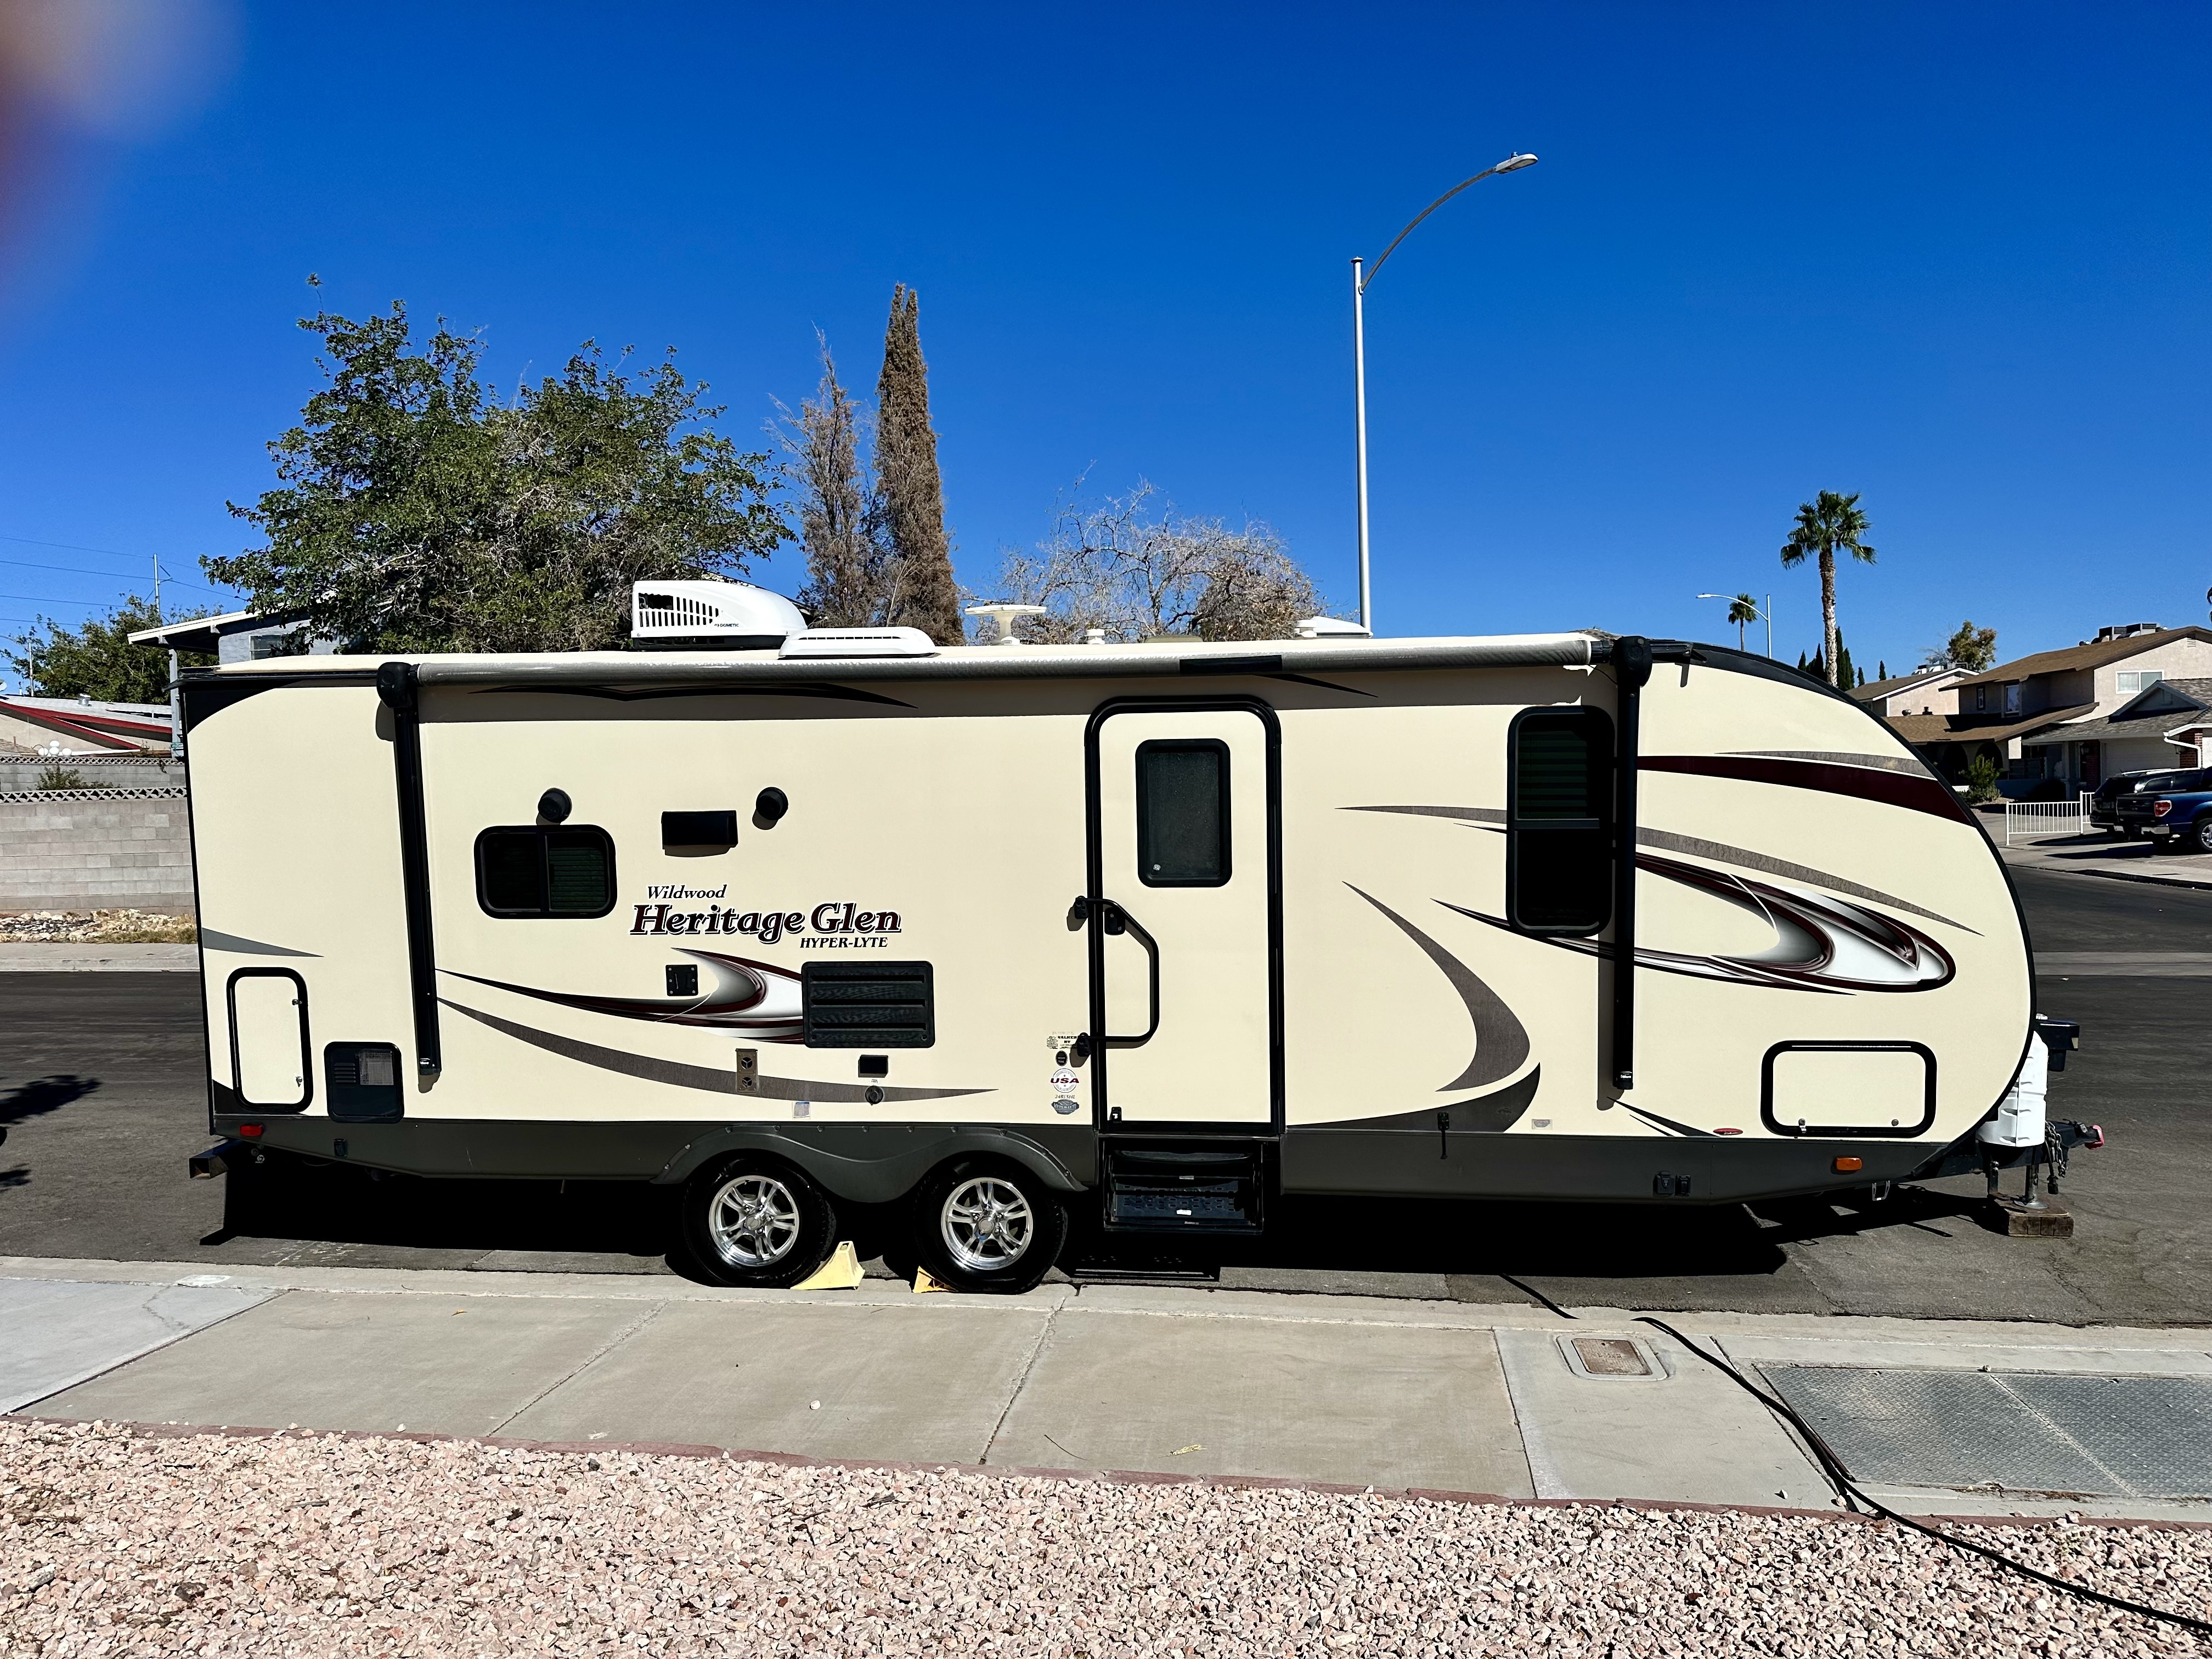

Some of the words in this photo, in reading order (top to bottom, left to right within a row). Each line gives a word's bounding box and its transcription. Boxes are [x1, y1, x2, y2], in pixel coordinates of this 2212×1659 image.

[647, 884, 727, 899] Wildwood
[630, 904, 805, 944] Heritage
[811, 902, 901, 934] Glen
[800, 937, 888, 949] HYPER-LYTE
